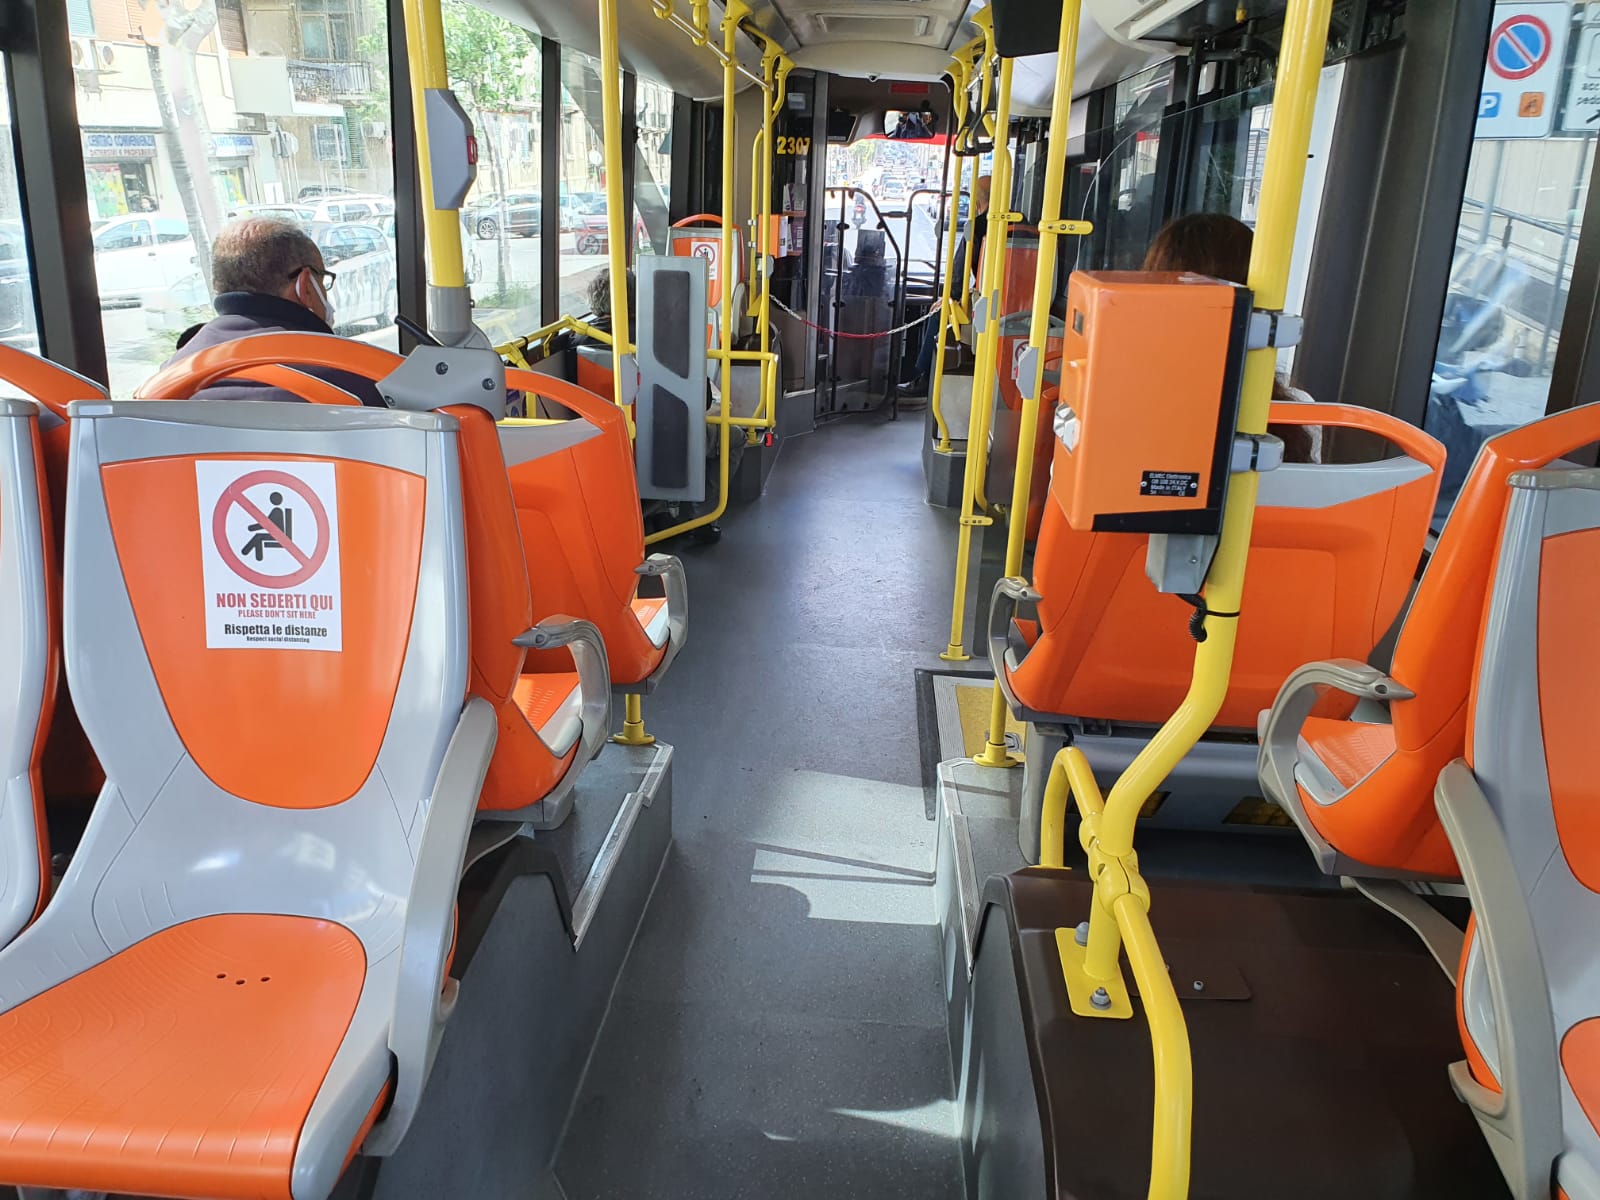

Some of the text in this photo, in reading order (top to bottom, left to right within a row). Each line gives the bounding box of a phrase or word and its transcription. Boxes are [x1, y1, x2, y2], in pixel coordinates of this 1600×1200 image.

[776, 136, 811, 156] 2307
[216, 593, 333, 611] NON SEDERTI QUI
[238, 609, 316, 619] PLEASE DON'T SIT HERE
[224, 623, 328, 637] Rispetta le distanze
